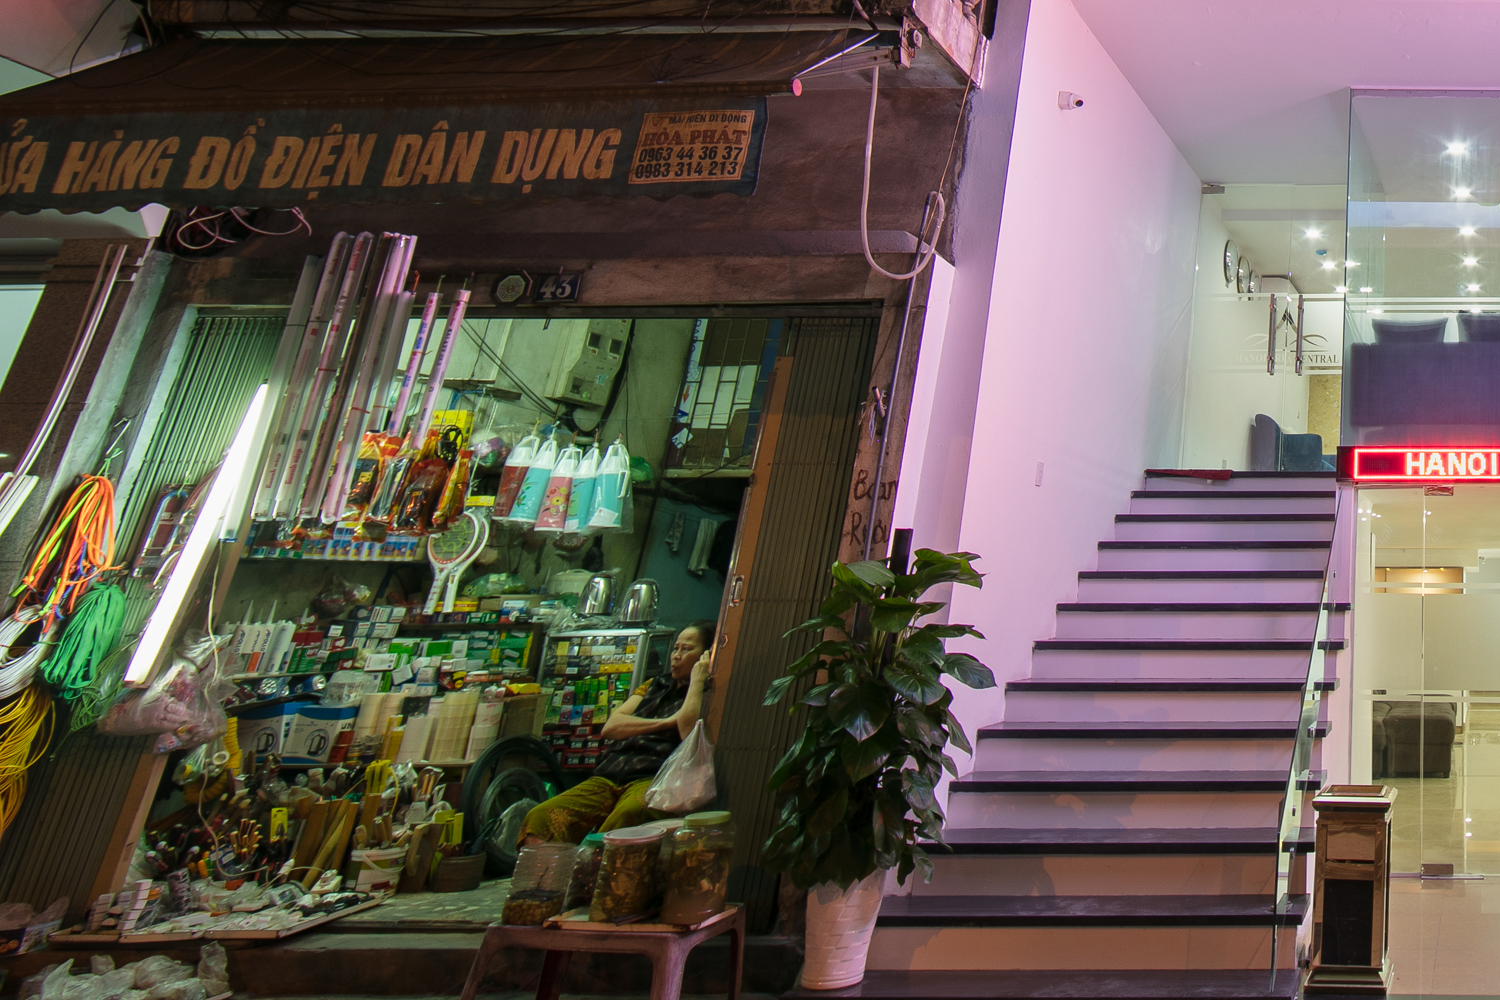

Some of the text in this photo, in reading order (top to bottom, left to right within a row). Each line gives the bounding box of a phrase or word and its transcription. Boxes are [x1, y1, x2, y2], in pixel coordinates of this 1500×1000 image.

[709, 114, 719, 123] DI
[688, 125, 748, 145] PHÁT
[258, 123, 378, 200] ĐIỆN
[381, 120, 486, 187] DÂN
[490, 128, 622, 194] DỤNG
[638, 146, 744, 163] 0963 44 36 37
[634, 161, 739, 179] 0983 314 213
[539, 275, 572, 299] 43
[1301, 354, 1339, 364] ENTRAL
[1406, 451, 1498, 476] HANOI
